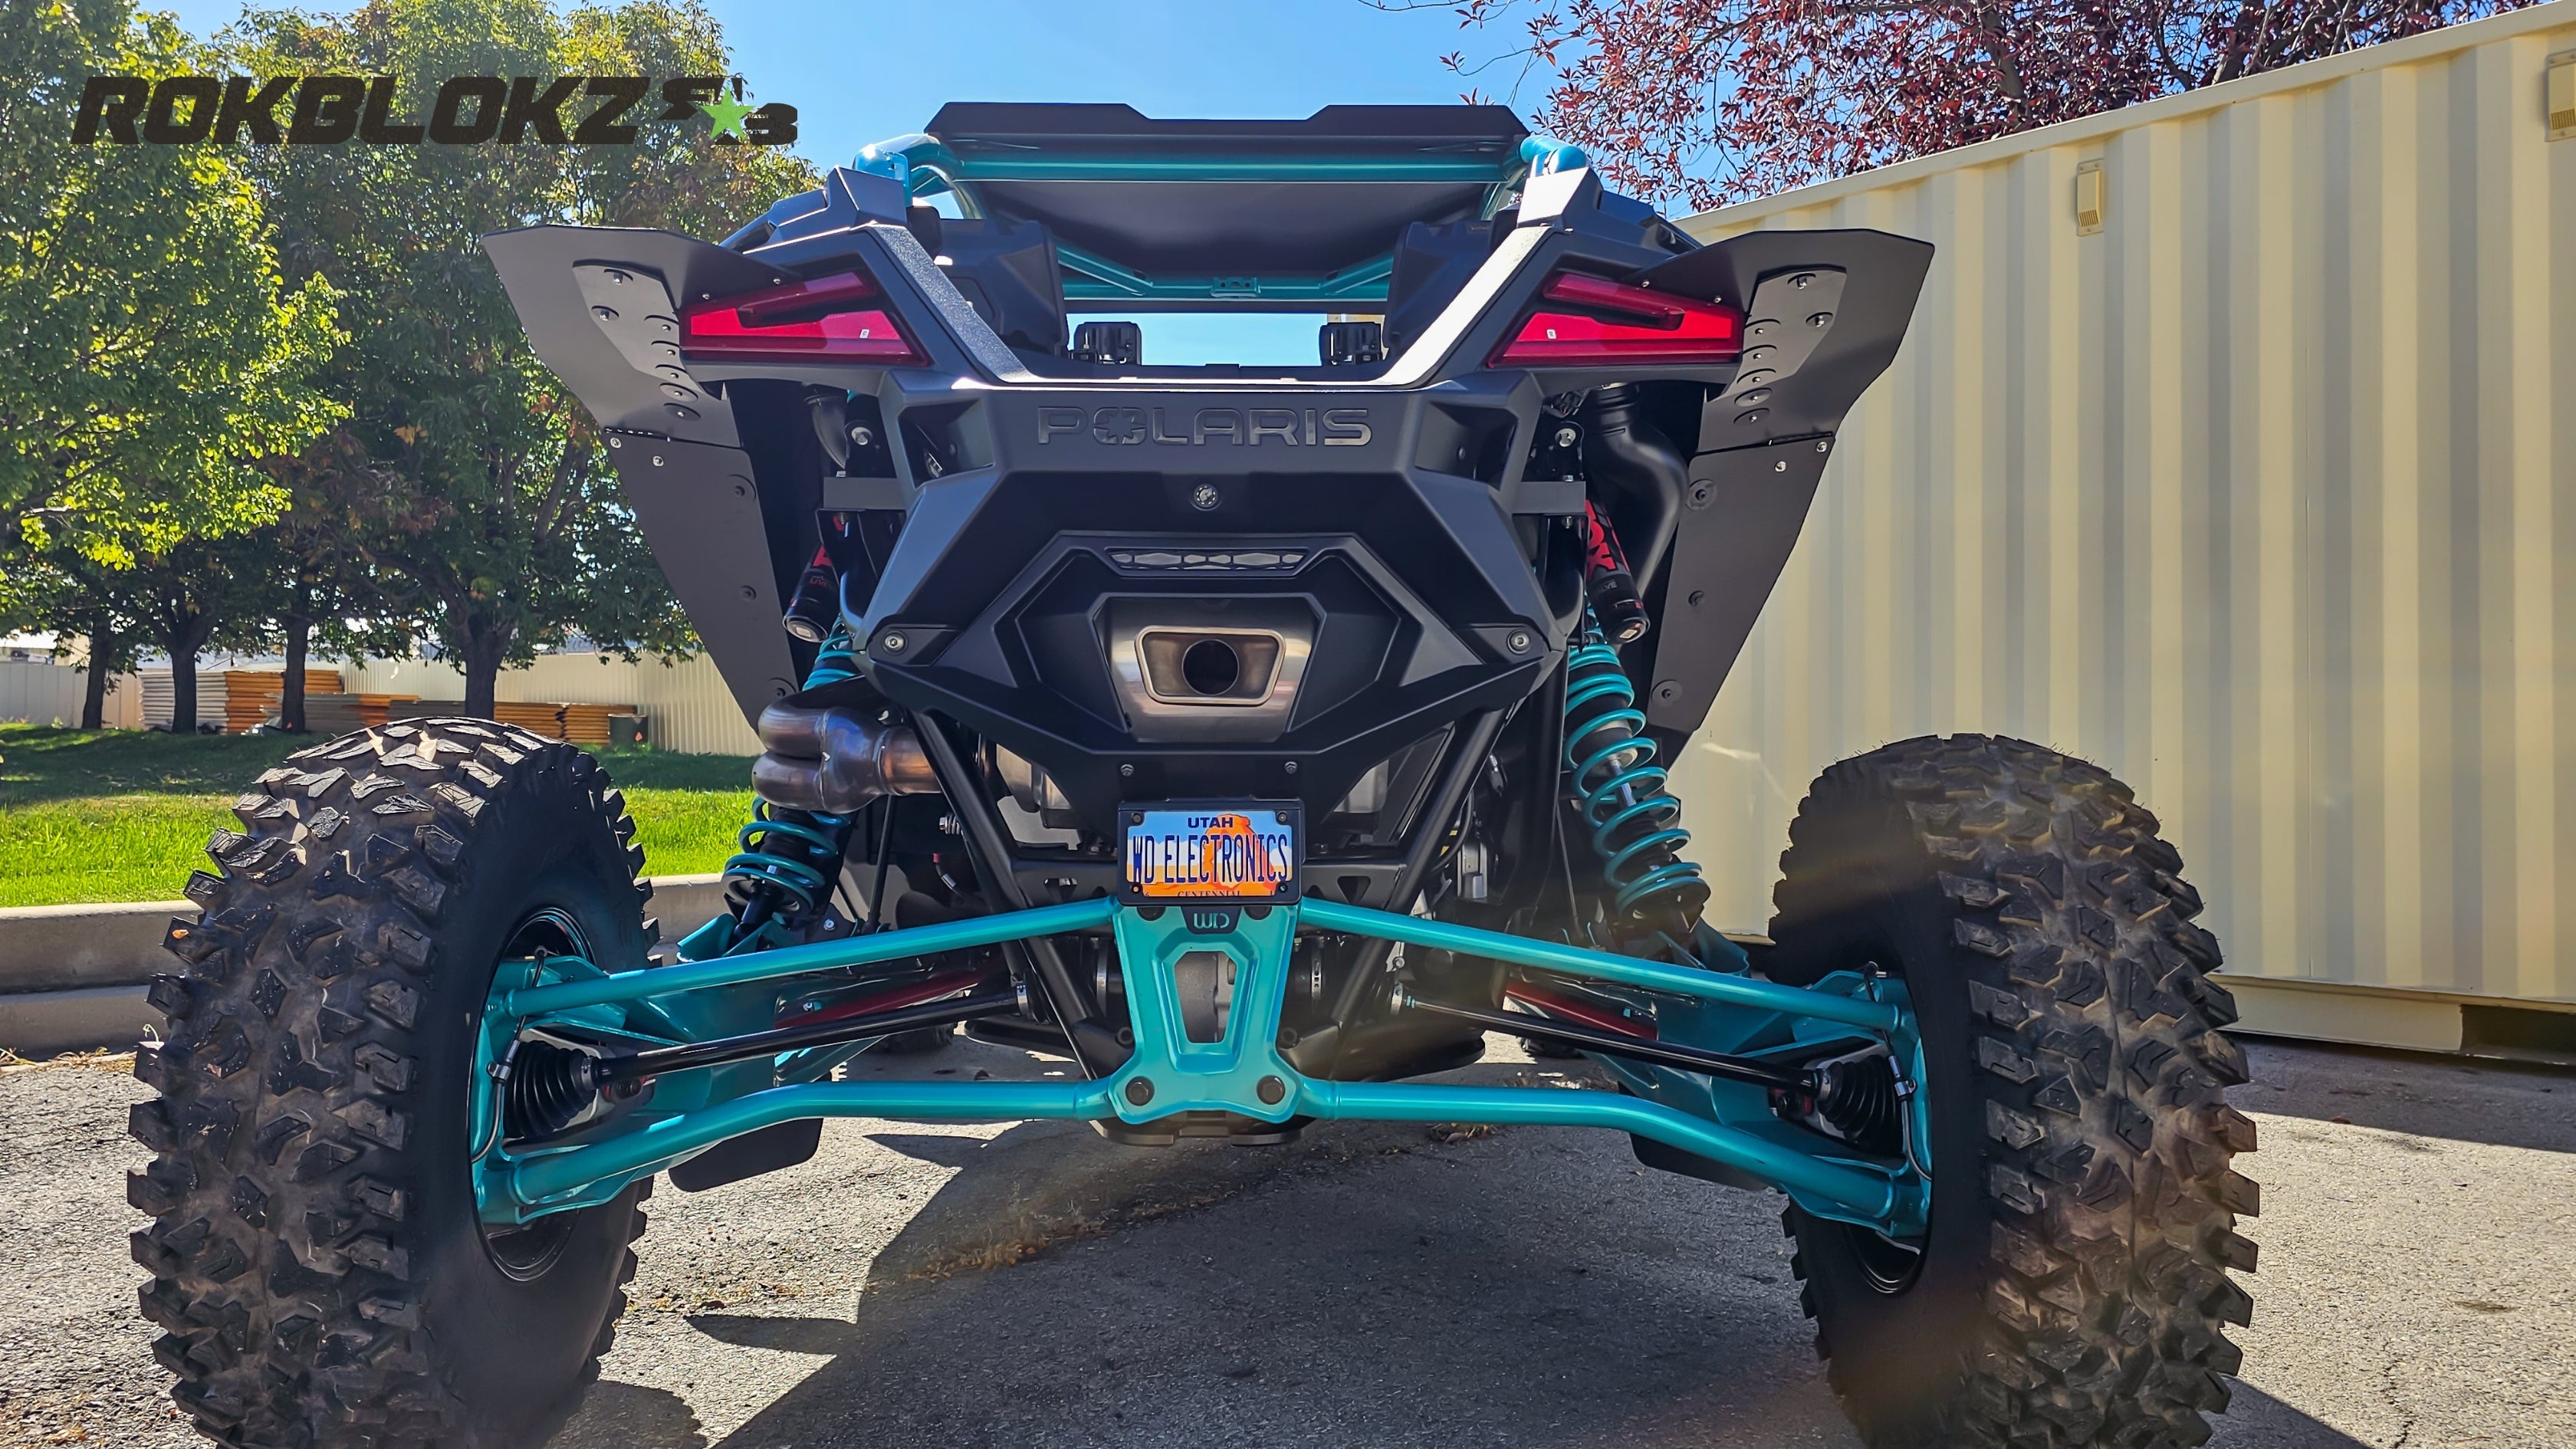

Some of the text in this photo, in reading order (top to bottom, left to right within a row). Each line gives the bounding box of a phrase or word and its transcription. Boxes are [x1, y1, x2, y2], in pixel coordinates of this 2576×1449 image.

[1037, 406, 1372, 446] POLARIS
[1188, 817, 1233, 828] UTAH
[1133, 833, 1288, 883] WD ELECTRONICS
